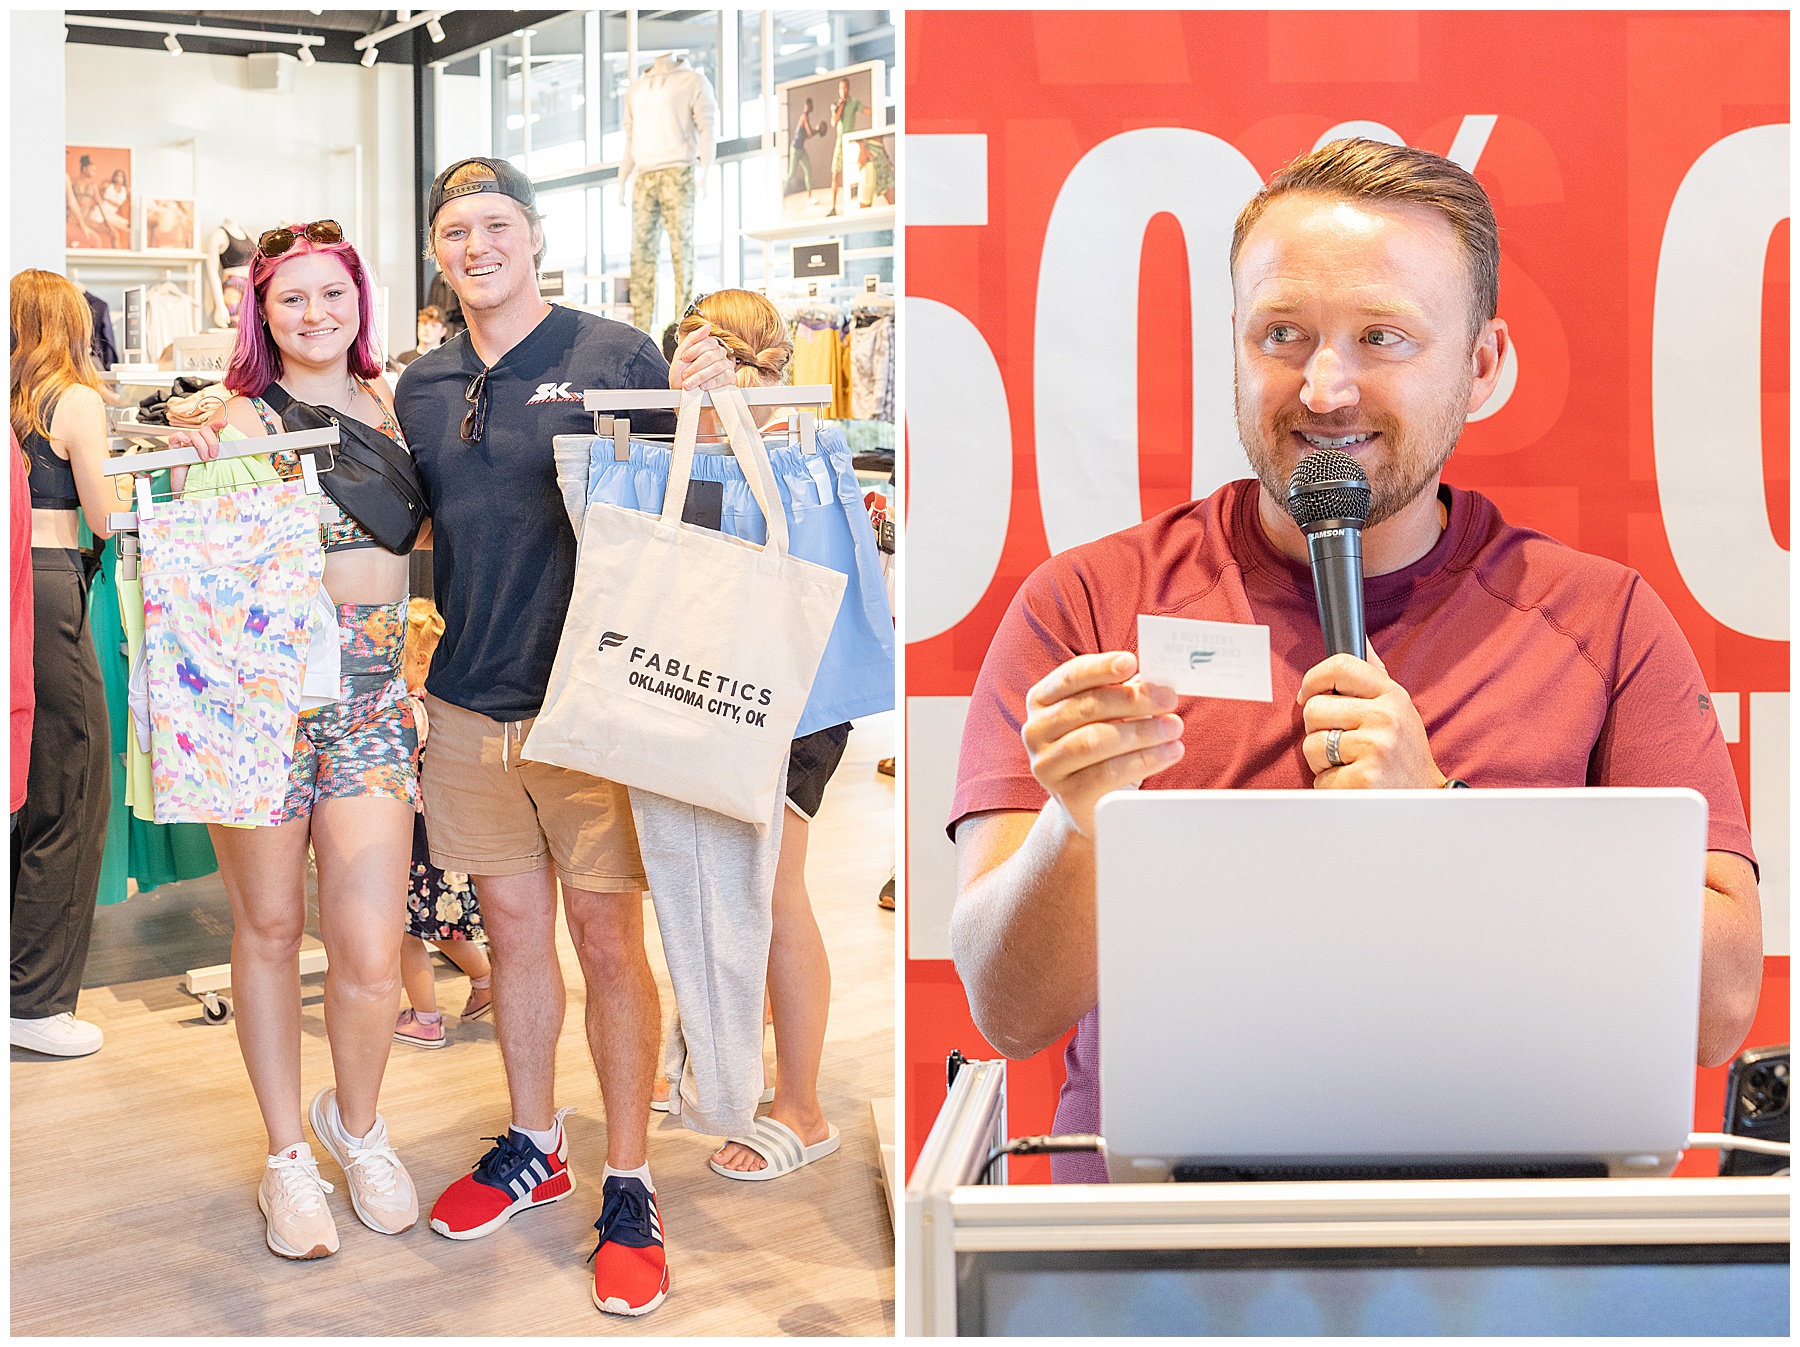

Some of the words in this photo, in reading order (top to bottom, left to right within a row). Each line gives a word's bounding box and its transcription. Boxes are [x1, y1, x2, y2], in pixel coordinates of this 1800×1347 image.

[528, 382, 574, 402] SK
[1309, 528, 1345, 541] SAMSON
[629, 646, 773, 706] FABLETICS
[628, 671, 703, 709] OKLAHOMA
[707, 698, 741, 724] CITY,
[745, 709, 767, 728] OK
